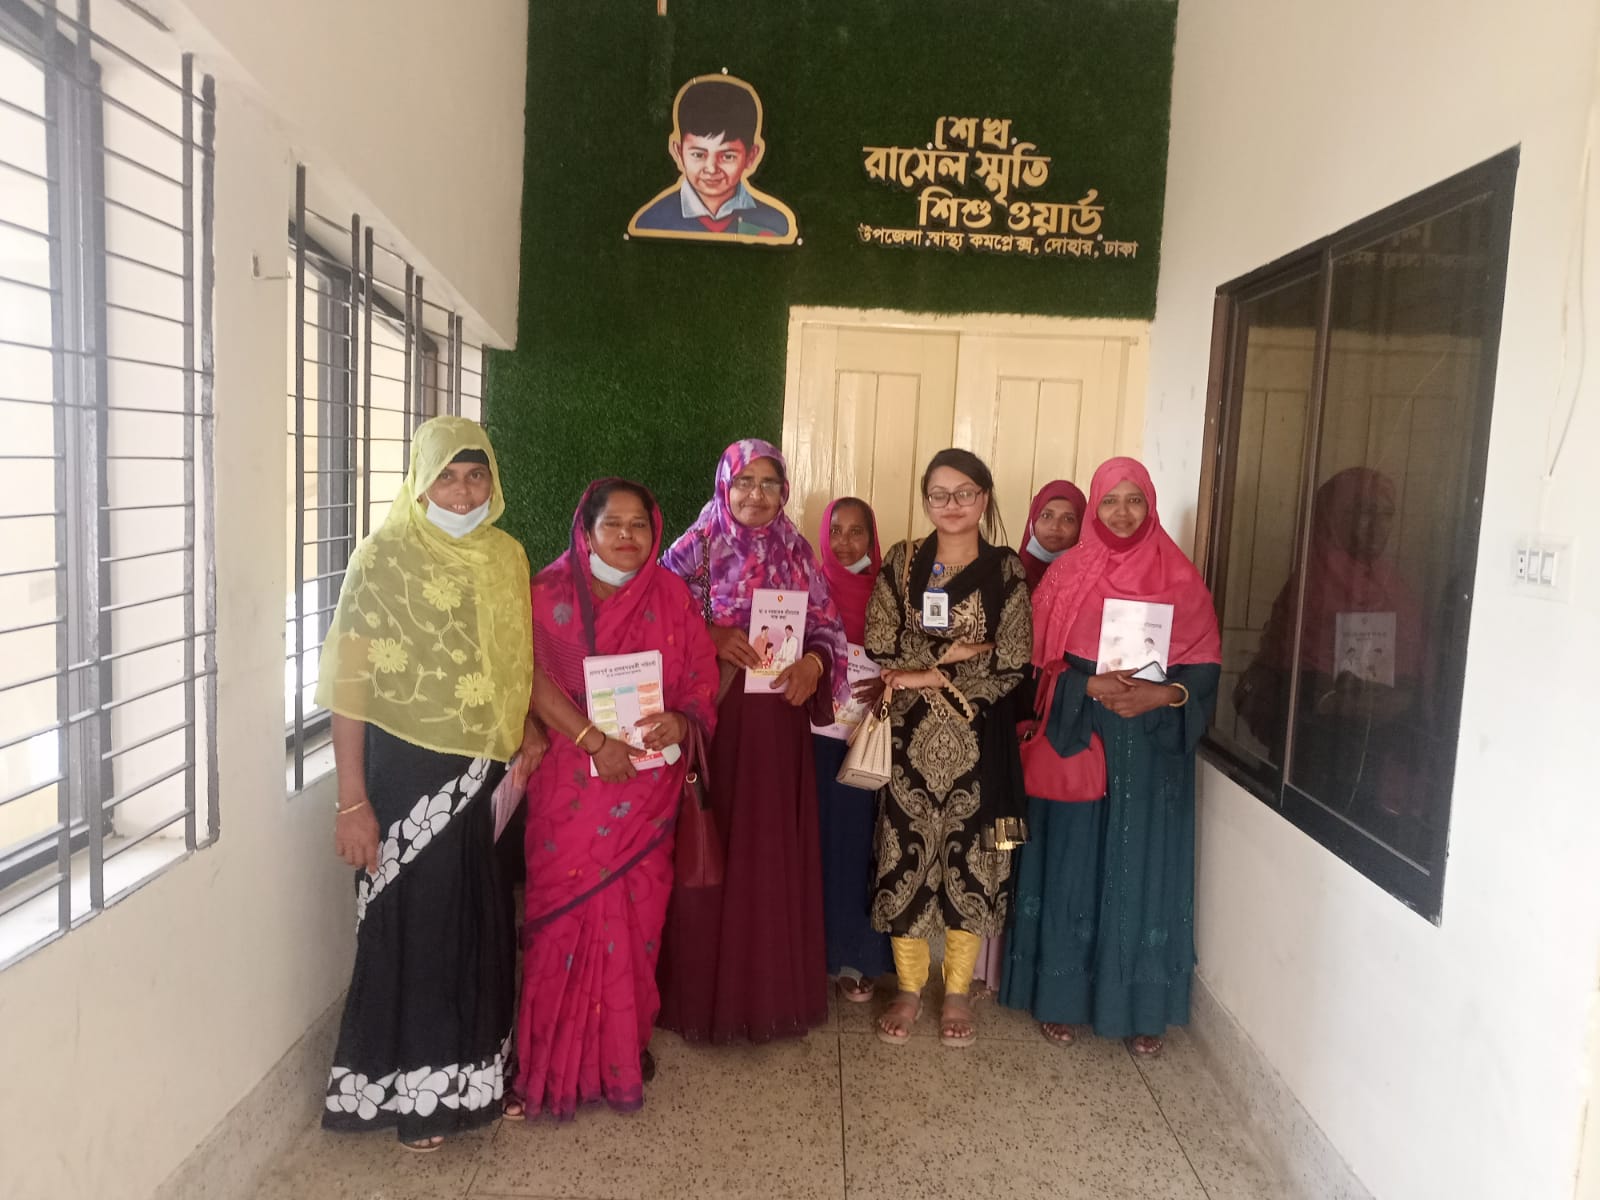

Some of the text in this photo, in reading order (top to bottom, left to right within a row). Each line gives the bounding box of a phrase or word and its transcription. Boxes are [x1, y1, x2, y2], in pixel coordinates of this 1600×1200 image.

[934, 116, 1012, 150] শেখ
[863, 142, 1051, 208] রাসেল স্মৃতি
[917, 185, 1104, 236] শিশু ওয়ার্ড
[857, 222, 923, 246] উপজেলা
[925, 230, 966, 252] স্বাস্থ্য
[1043, 236, 1100, 258] দোহার,
[1102, 240, 1139, 259] ঢাকা
